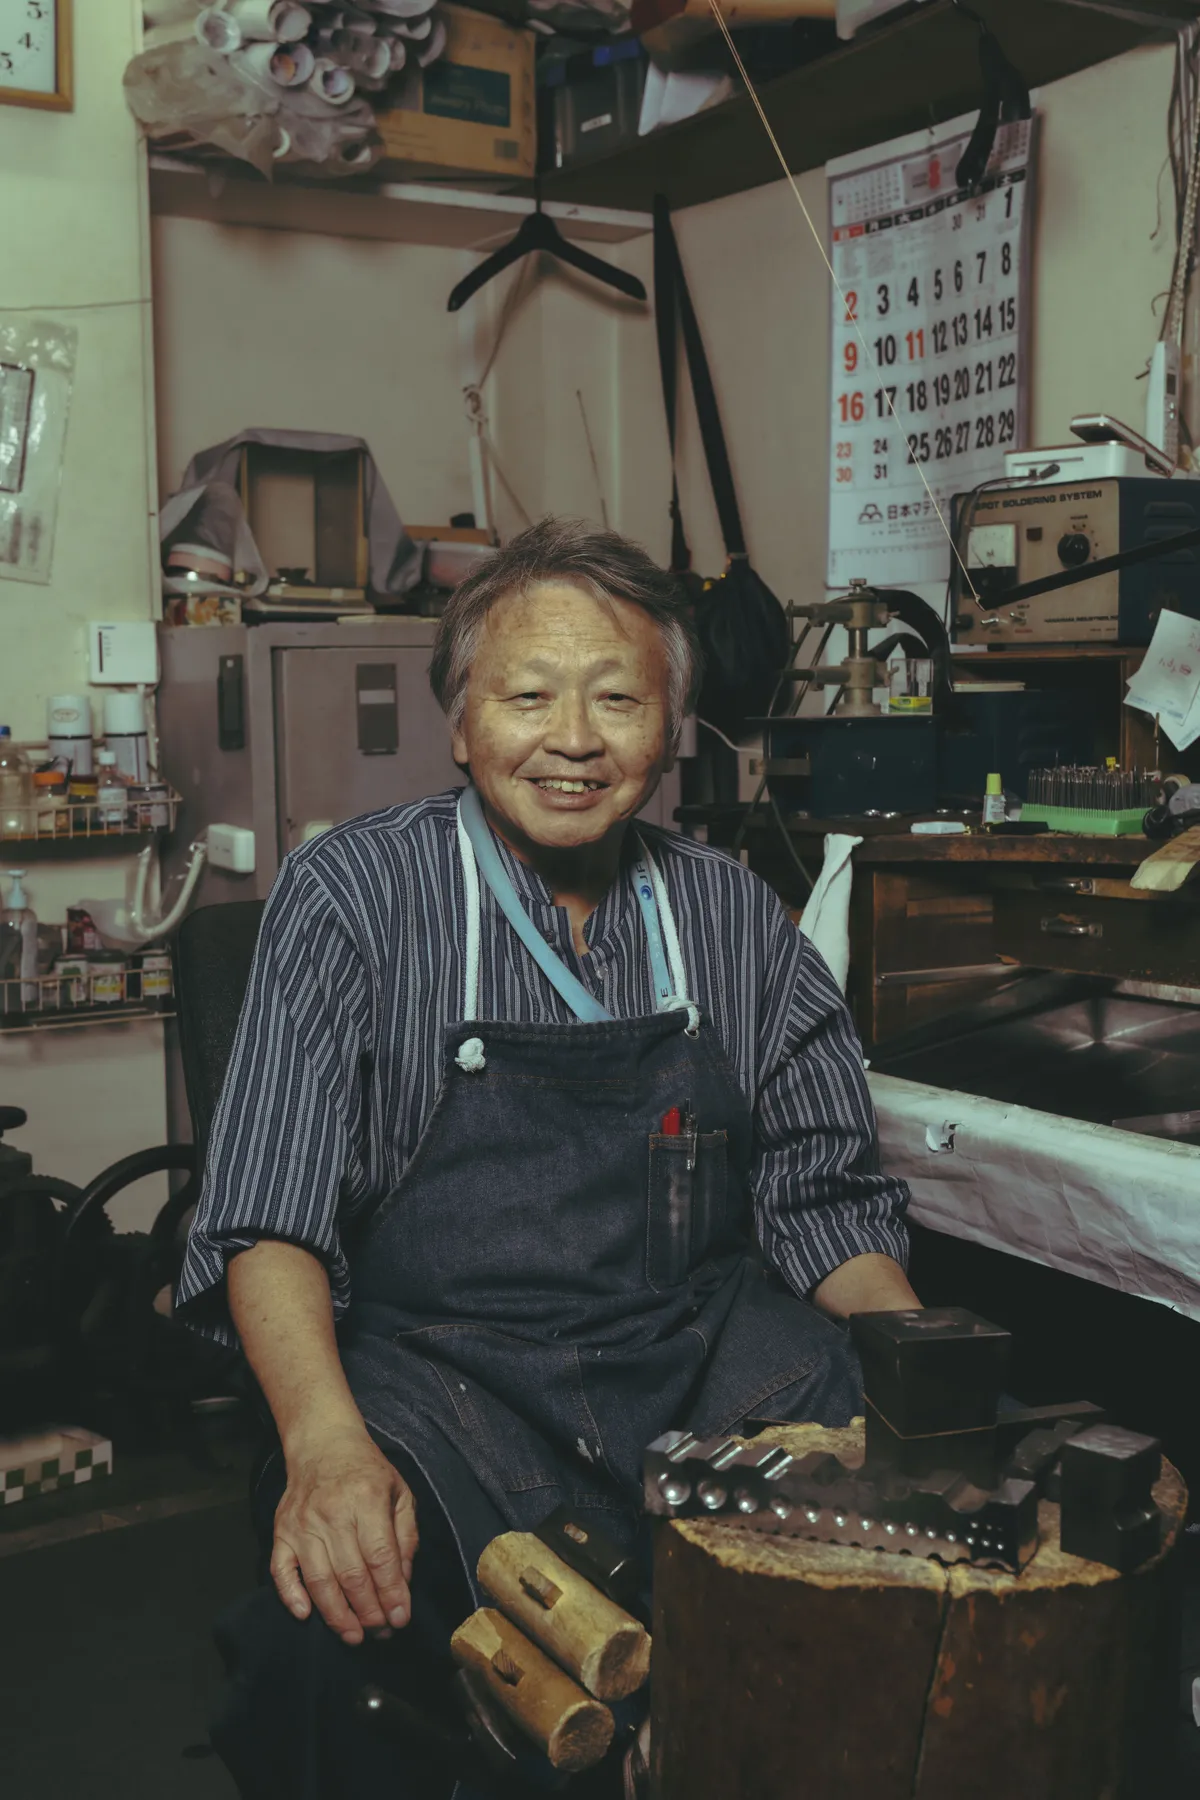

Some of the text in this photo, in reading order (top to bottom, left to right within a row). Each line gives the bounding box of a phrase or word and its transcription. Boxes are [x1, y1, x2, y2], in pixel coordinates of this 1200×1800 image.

[17, 32, 31, 49] 4
[1004, 187, 1013, 218] 1
[845, 242, 1011, 321] 2 3 4 5 6 7 8
[844, 297, 1015, 372] 9 10 11 12 13 14 15
[838, 353, 1016, 422] 16 17 18 19 20 21 22
[836, 409, 1015, 464] 23 24 25 26 27 28 29
[836, 464, 888, 482] 30 31
[1002, 494, 1056, 508] SOLDERING
[1059, 489, 1103, 502] SYSTEM
